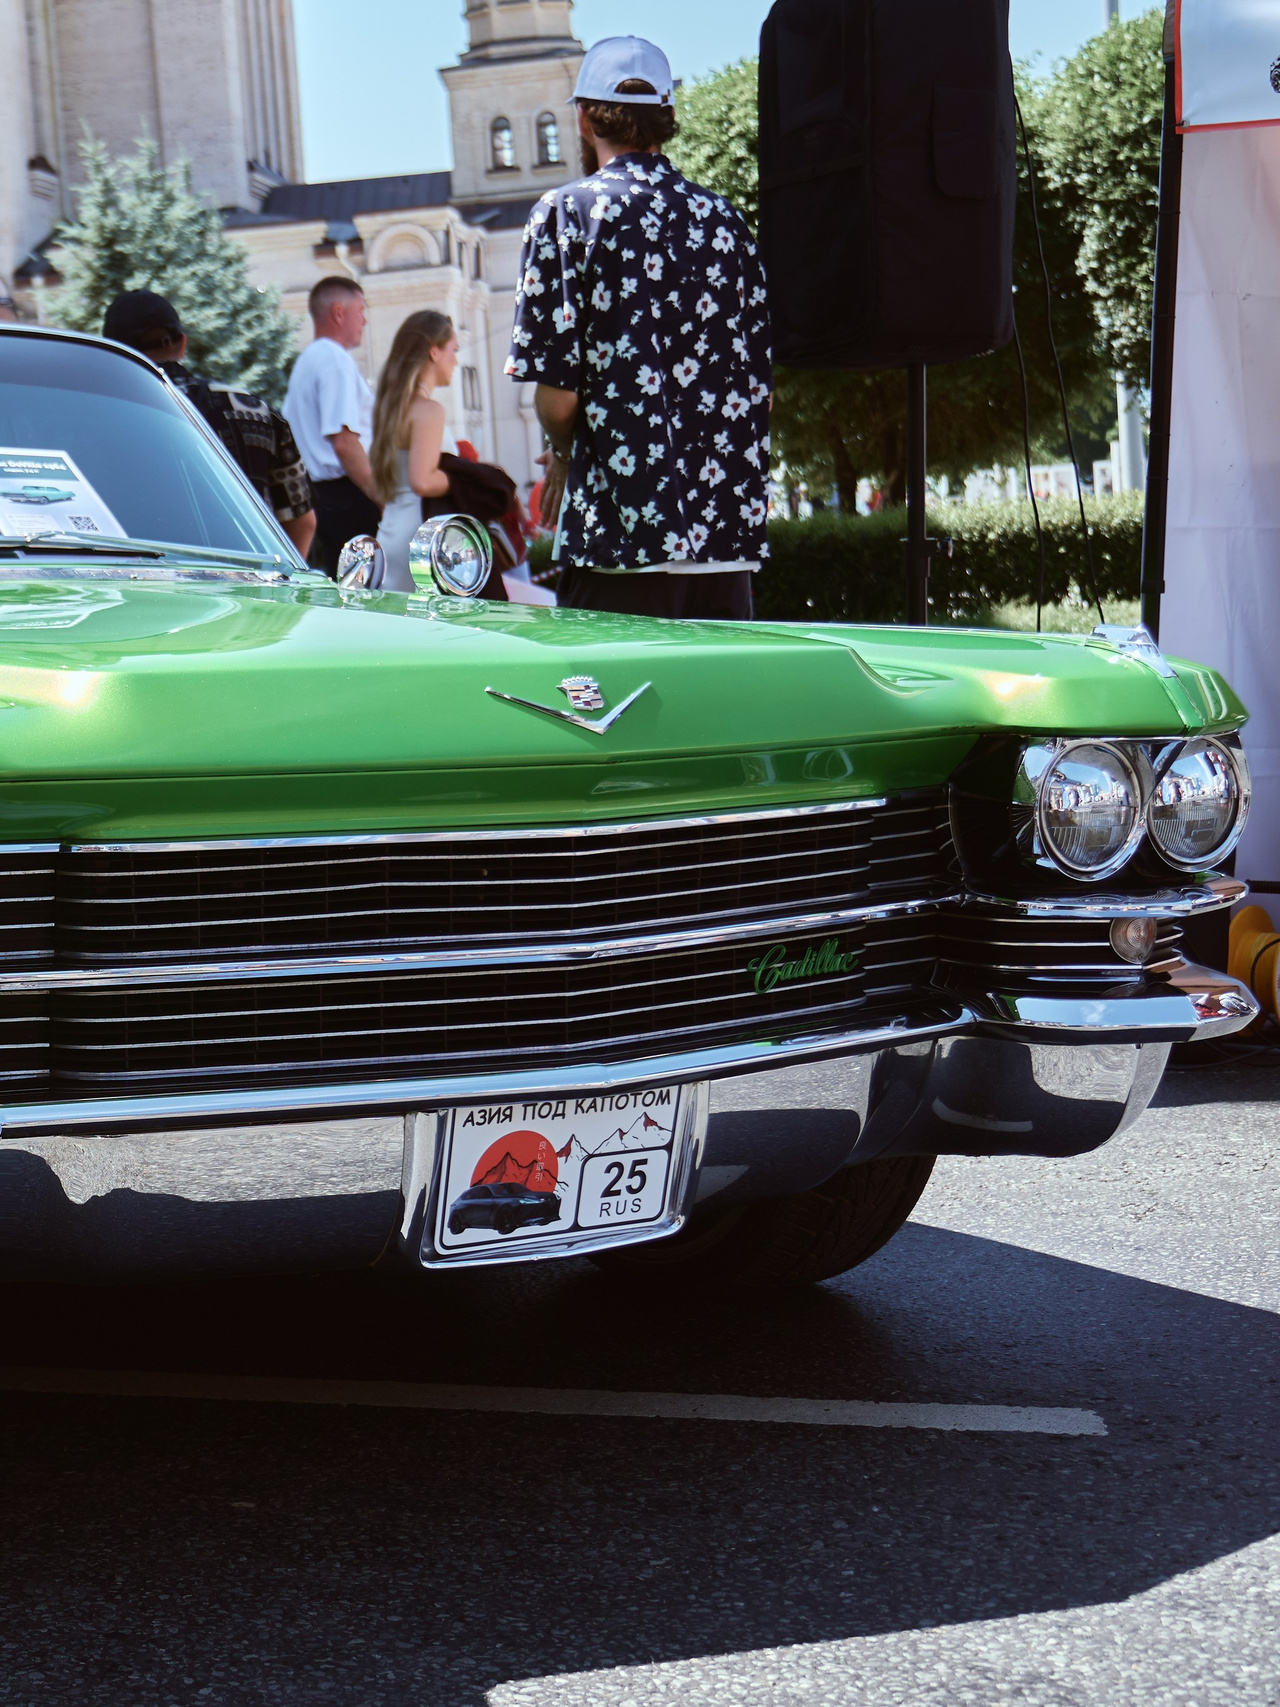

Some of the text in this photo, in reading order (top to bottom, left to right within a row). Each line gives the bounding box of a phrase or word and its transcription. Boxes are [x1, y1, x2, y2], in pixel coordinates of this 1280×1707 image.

[747, 938, 858, 994] Cadillac
[462, 1089, 671, 1127] АЗИЯ ПОД КАПОТОМ
[600, 1158, 648, 1198] 25
[599, 1198, 642, 1217] RUS
